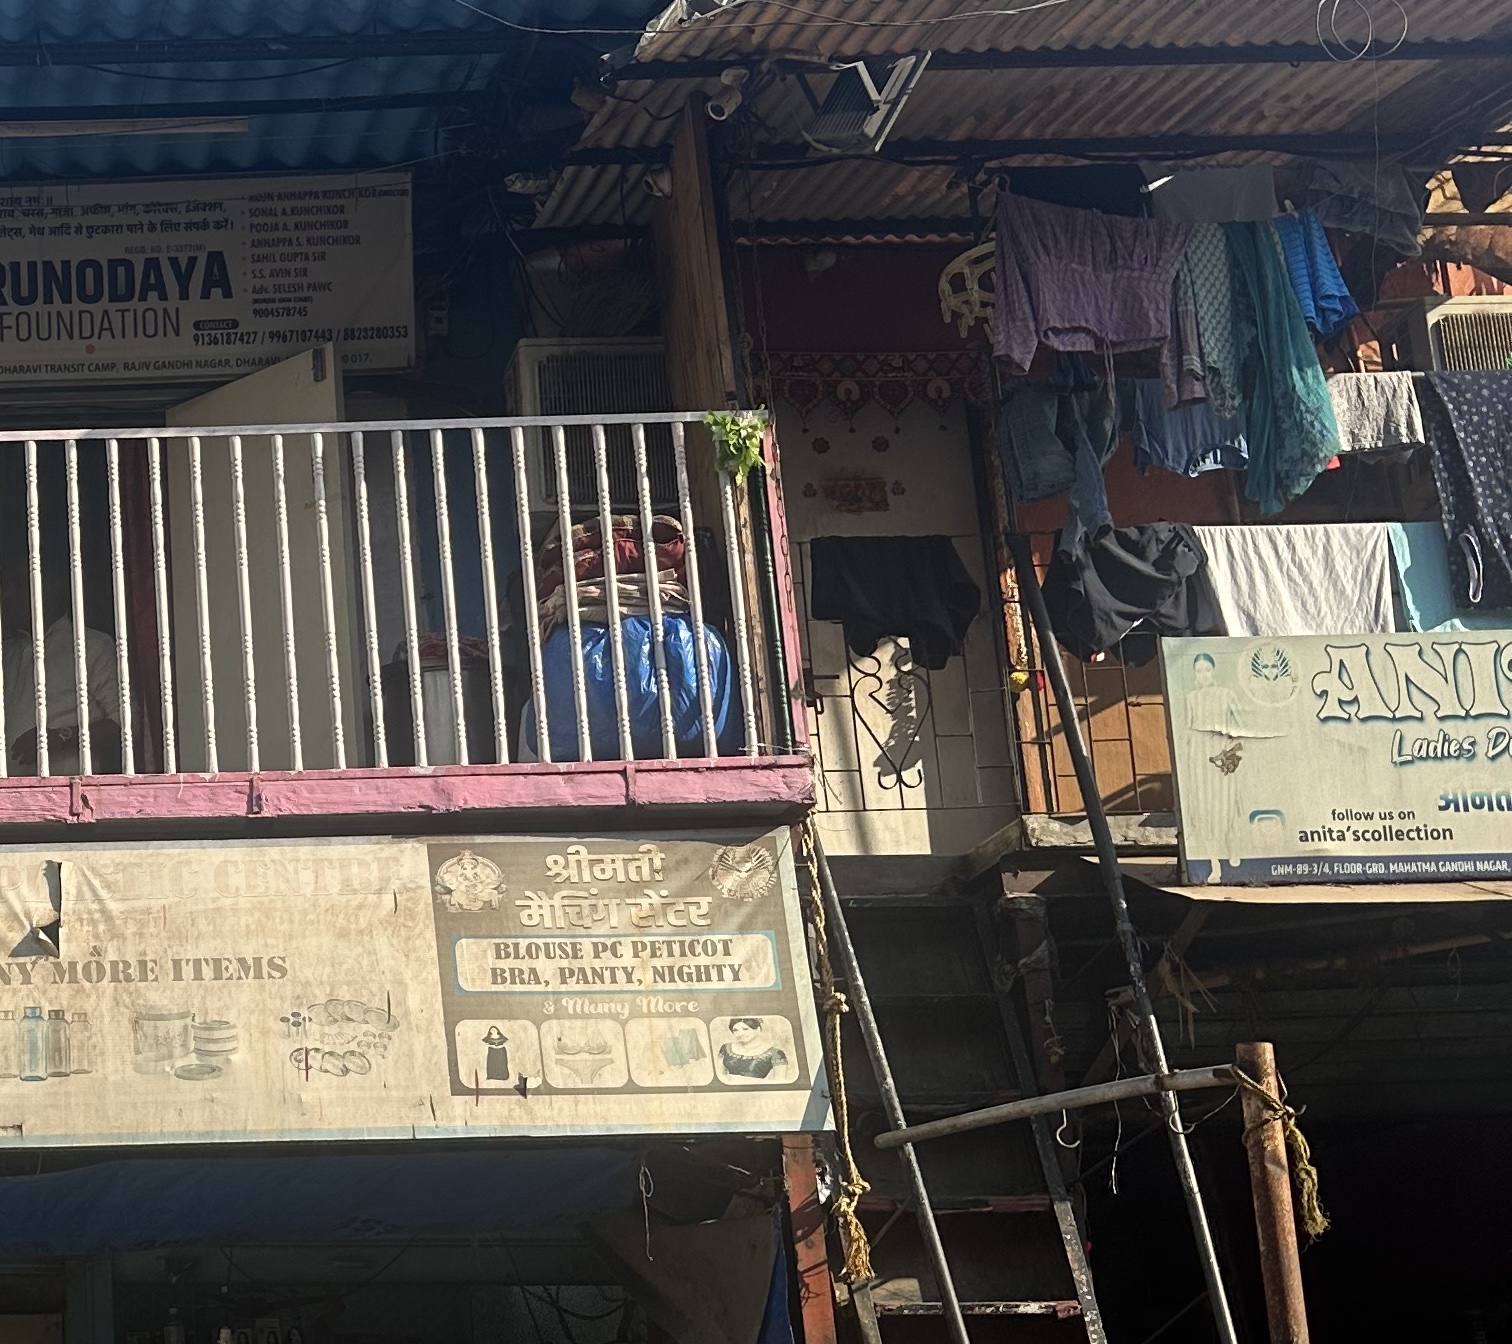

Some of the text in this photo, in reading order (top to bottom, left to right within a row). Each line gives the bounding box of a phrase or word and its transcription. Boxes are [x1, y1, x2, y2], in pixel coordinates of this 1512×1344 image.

[248, 206, 278, 218] SONAL
[48, 222, 70, 236] आदि
[74, 222, 83, 236] से
[126, 221, 144, 234] पाने
[146, 220, 158, 233] के
[160, 219, 181, 233] लिए
[250, 220, 348, 234] POOJA A. KUNCHIKOR
[250, 234, 362, 248] ANNAPPA S. KUNCHIKOR
[250, 252, 327, 264] SAHIL GUPTA SIR
[252, 268, 308, 280] S.S. AVIN SIR
[272, 284, 304, 294] SELESH
[252, 306, 308, 318] 9004578745
[0, 306, 181, 342] FOUNDATION
[200, 320, 233, 330] CONTACT
[192, 332, 258, 347] 9136187427
[268, 328, 333, 344] 9967107443
[44, 363, 86, 374] TRANSIT
[87, 362, 120, 374] CAMP,
[124, 360, 150, 372] RAJIV
[153, 359, 194, 371] GANDHI
[195, 358, 234, 370] NAGAR,
[1390, 728, 1476, 765] Ladies
[1331, 808, 1416, 822] follow us on
[544, 843, 666, 884] श्रीमती
[1390, 861, 1437, 873] MAHATMA
[1438, 860, 1474, 872] GANDHI
[1476, 860, 1511, 873] NAGAR,
[515, 887, 713, 930] मैचिंग सेंटर
[493, 938, 734, 960] BLOUSE PC PETICOT
[50, 959, 159, 985] MORE
[170, 956, 288, 982] ITEMS
[490, 963, 744, 988] BRA, PANTY, NIGHTY
[542, 994, 700, 1020] & Many More
